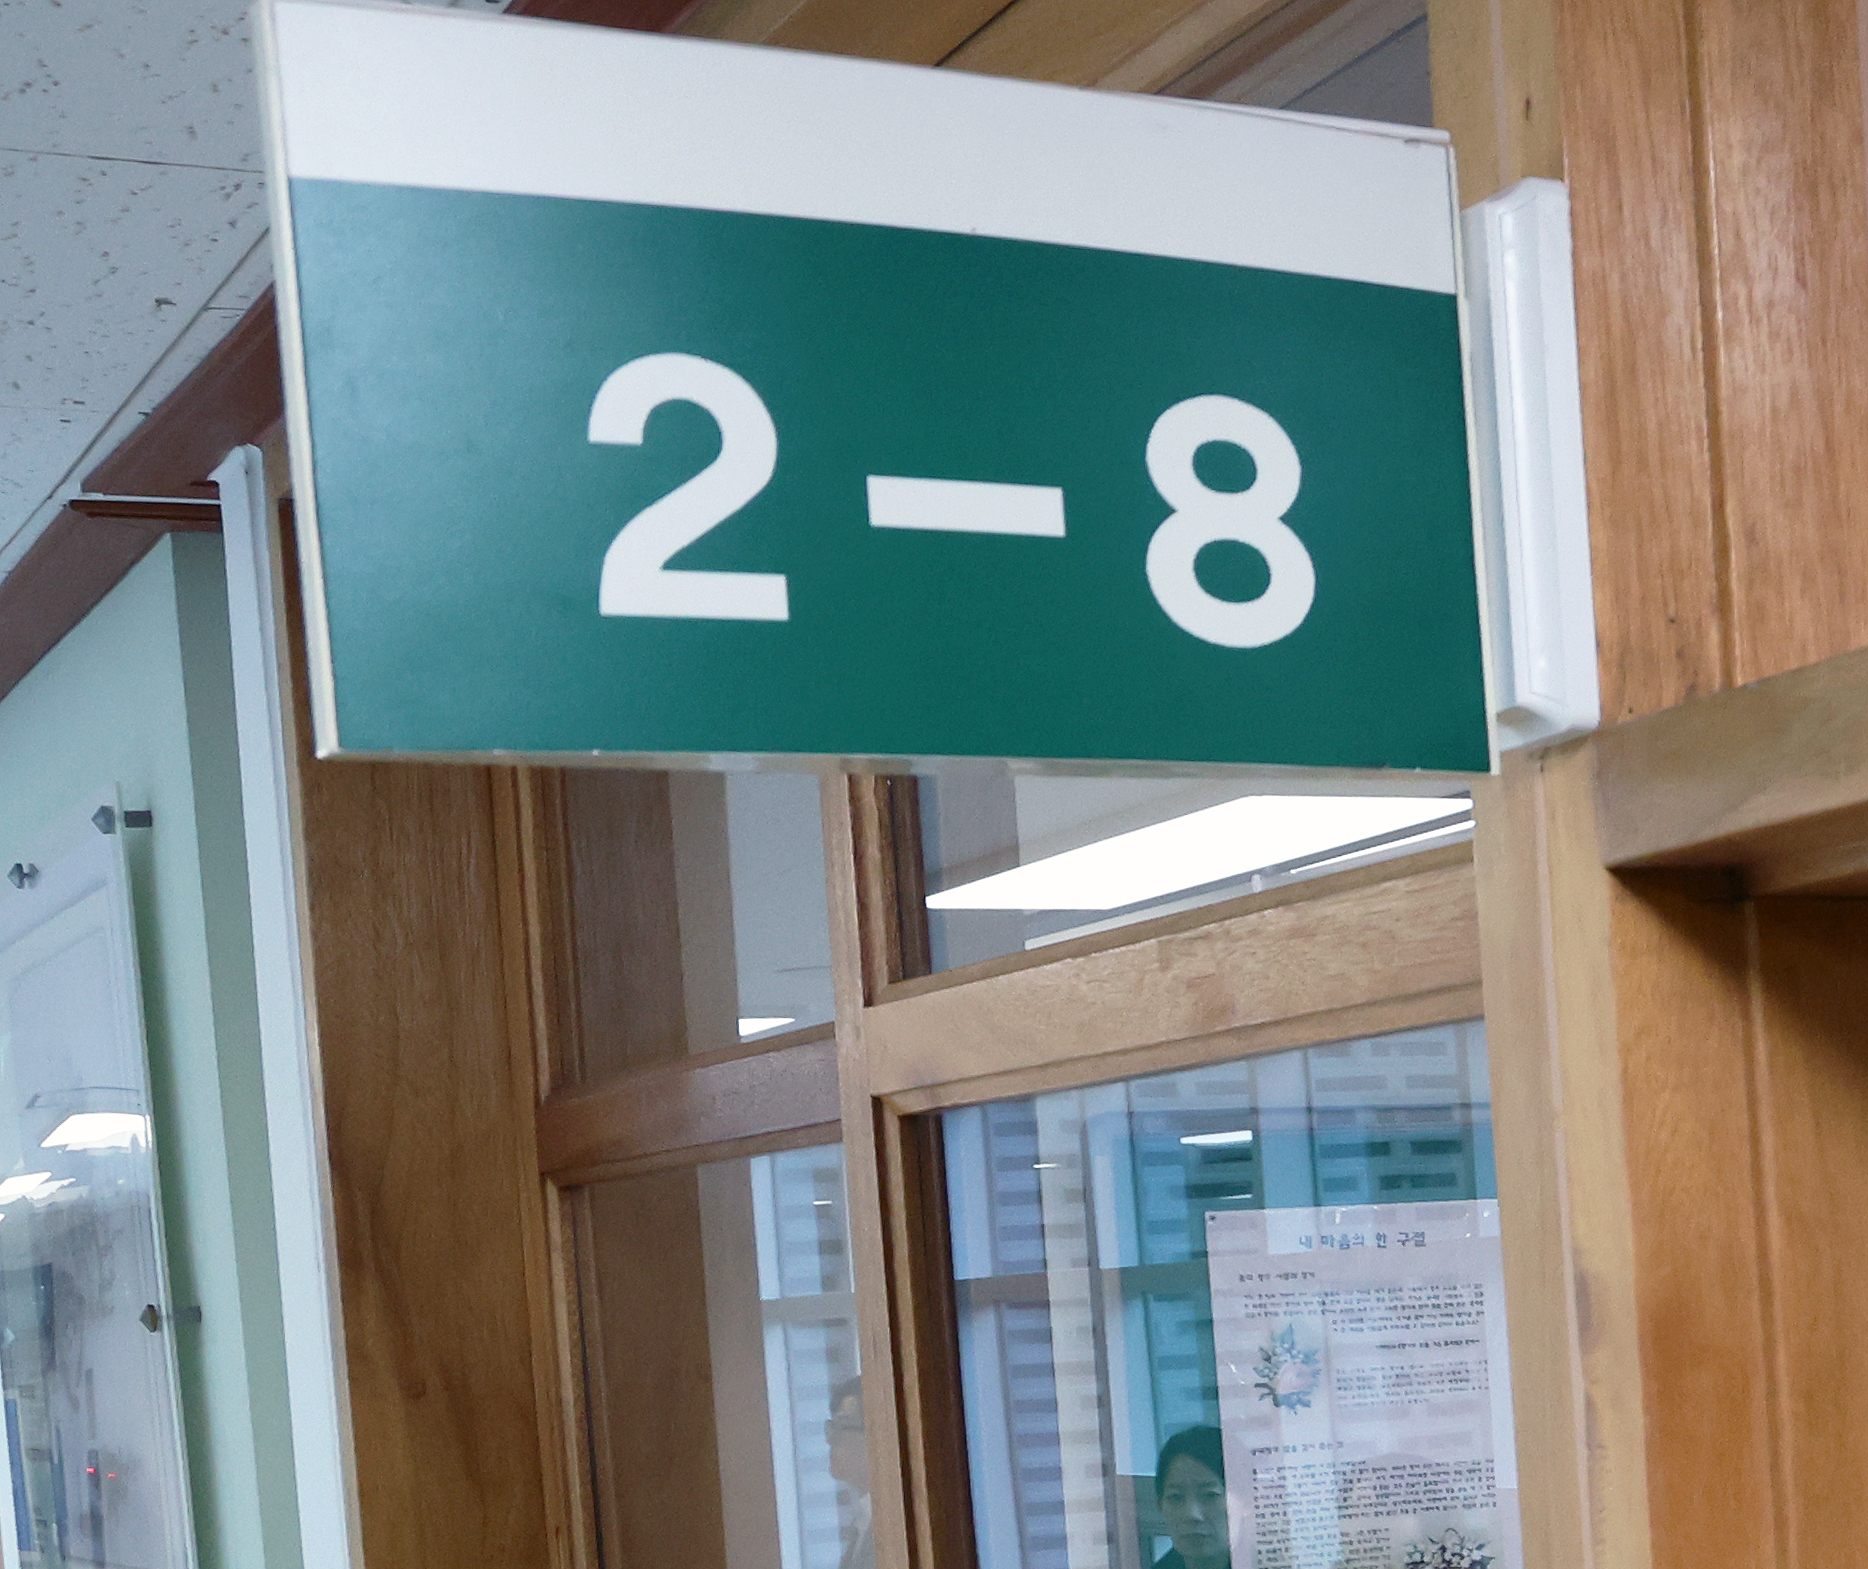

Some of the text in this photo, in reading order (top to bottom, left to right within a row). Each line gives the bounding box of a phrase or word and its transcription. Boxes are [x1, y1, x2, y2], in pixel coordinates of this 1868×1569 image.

[587, 351, 1316, 649] 2-8
[1299, 1230, 1427, 1250] 내 마음의 한 구절
